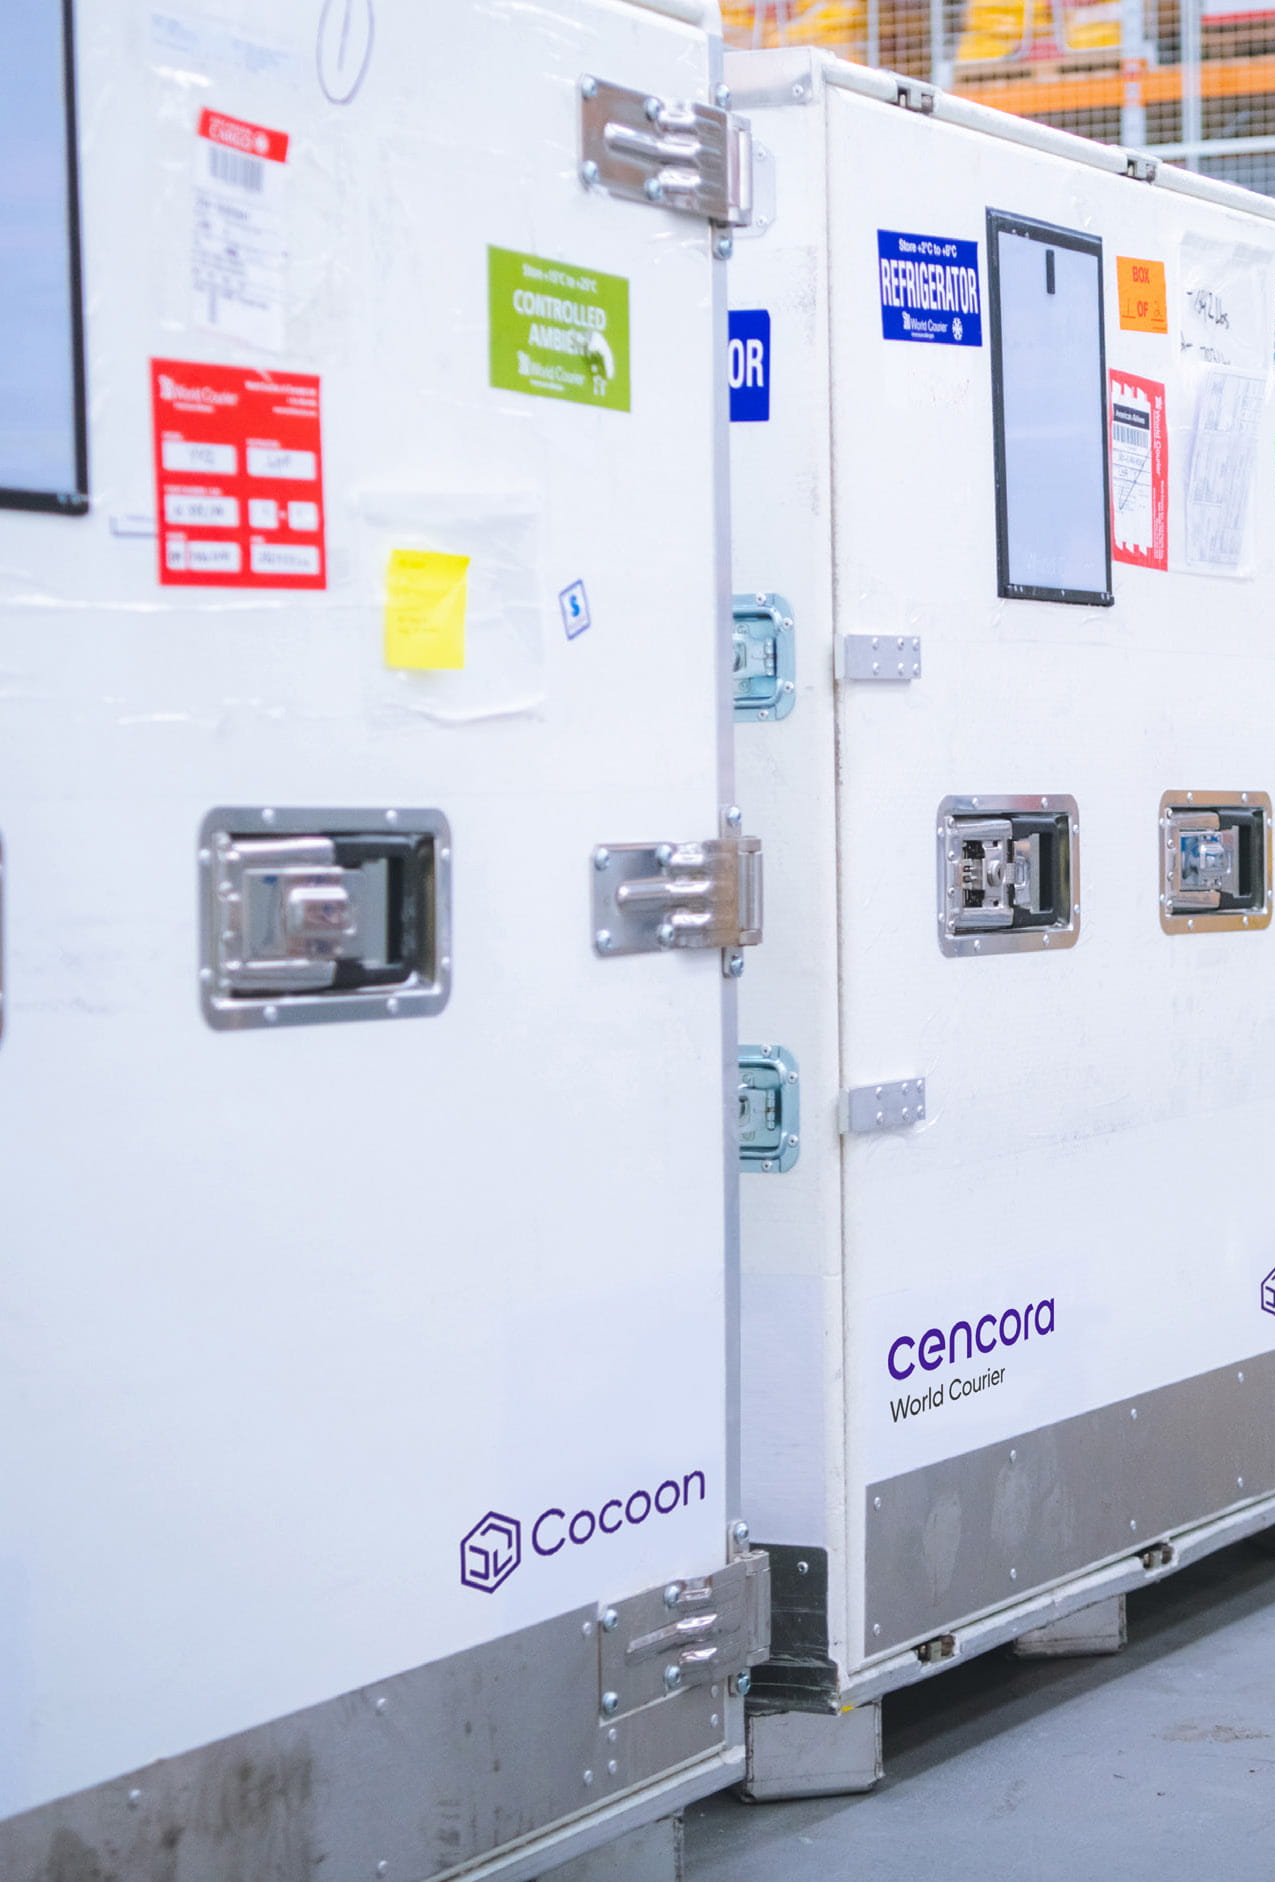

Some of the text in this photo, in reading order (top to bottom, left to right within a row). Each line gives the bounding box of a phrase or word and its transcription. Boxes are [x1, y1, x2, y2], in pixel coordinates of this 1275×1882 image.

[899, 238, 916, 252] Store
[934, 243, 940, 256] to
[880, 258, 979, 314] REFRIGERATOR
[1132, 266, 1150, 284] BOX
[513, 289, 607, 331] CONTROLLED
[1137, 300, 1149, 317] OF
[888, 1298, 1055, 1381] cencora
[890, 1368, 1006, 1423] World Courier
[532, 1470, 706, 1556] Cocoon
